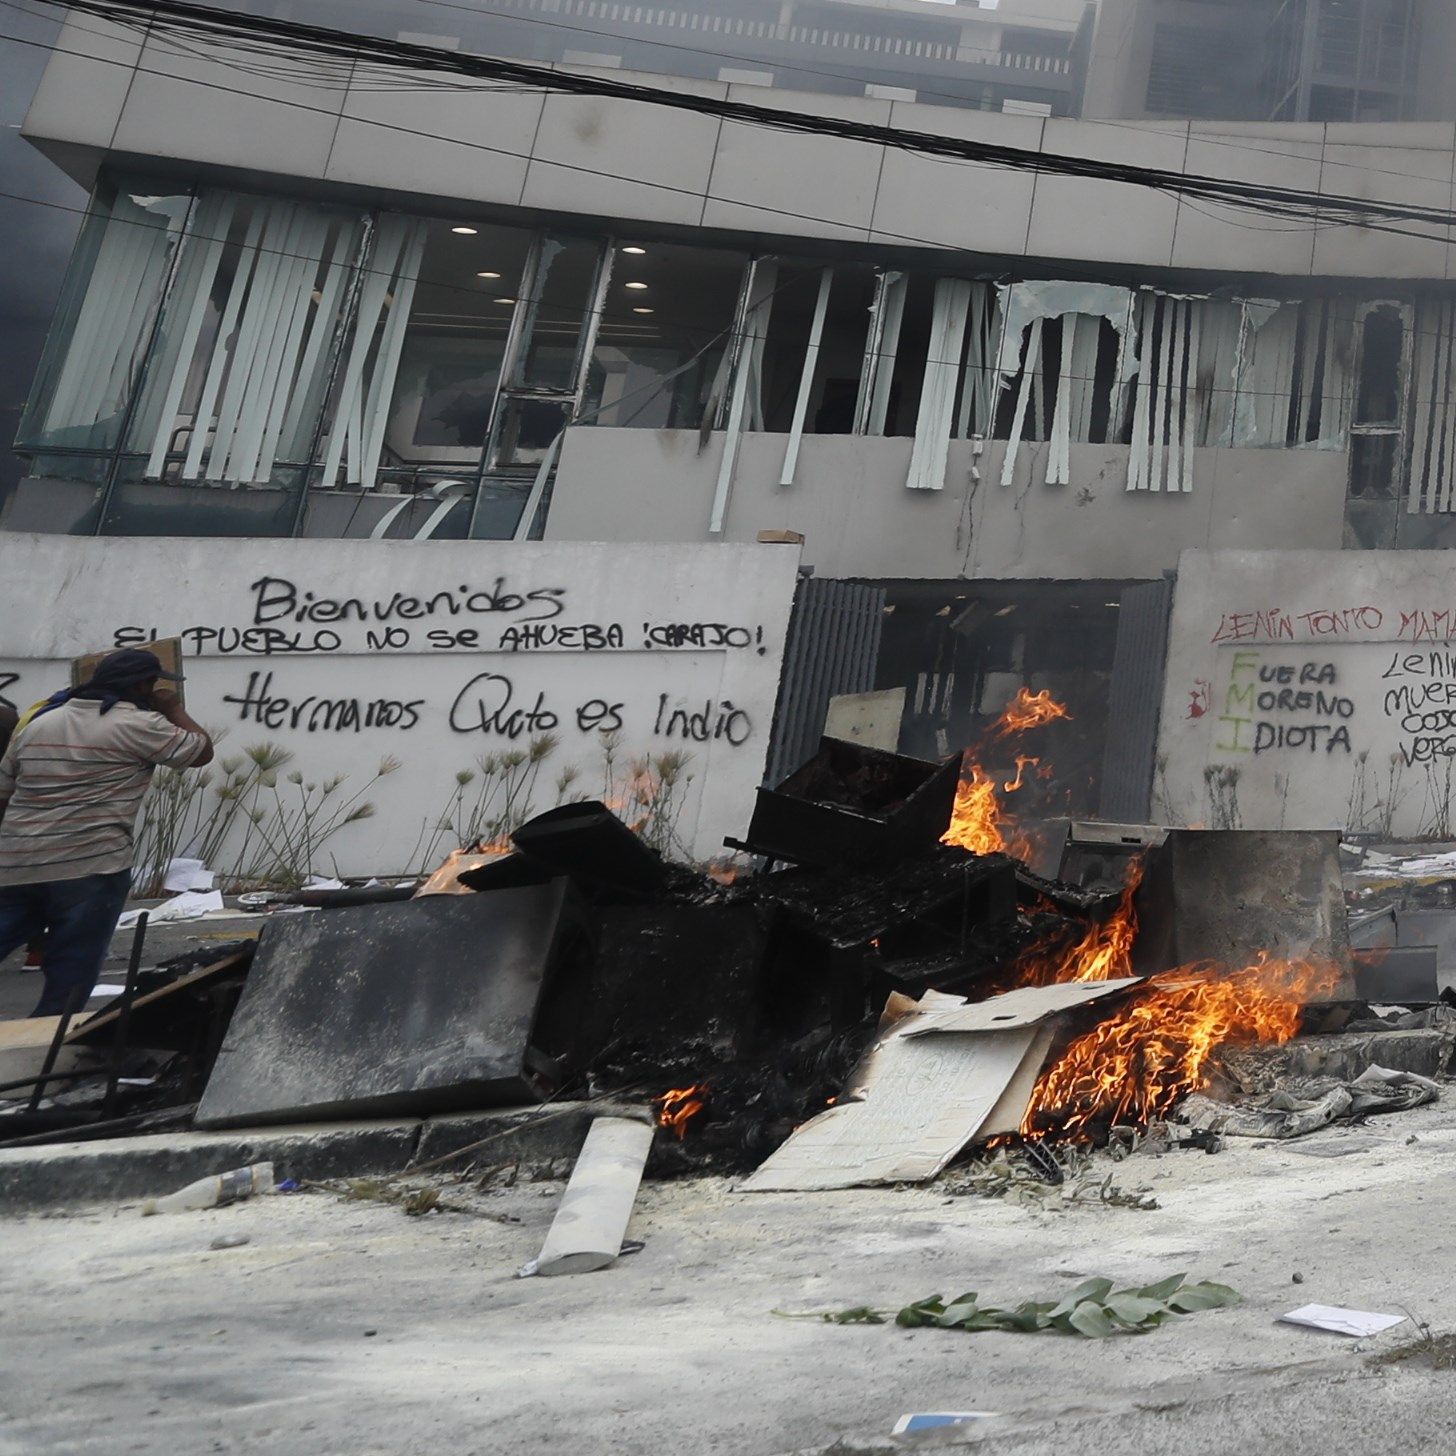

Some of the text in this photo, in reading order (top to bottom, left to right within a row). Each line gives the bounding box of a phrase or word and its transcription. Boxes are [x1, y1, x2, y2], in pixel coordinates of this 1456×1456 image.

[252, 577, 566, 624] Bienvenidos
[181, 626, 341, 655] PUEBLO
[367, 627, 410, 649] NO
[499, 624, 624, 651] AHUEBA
[223, 671, 425, 732] Hermanos
[576, 699, 625, 732] es
[654, 693, 750, 745] Indio
